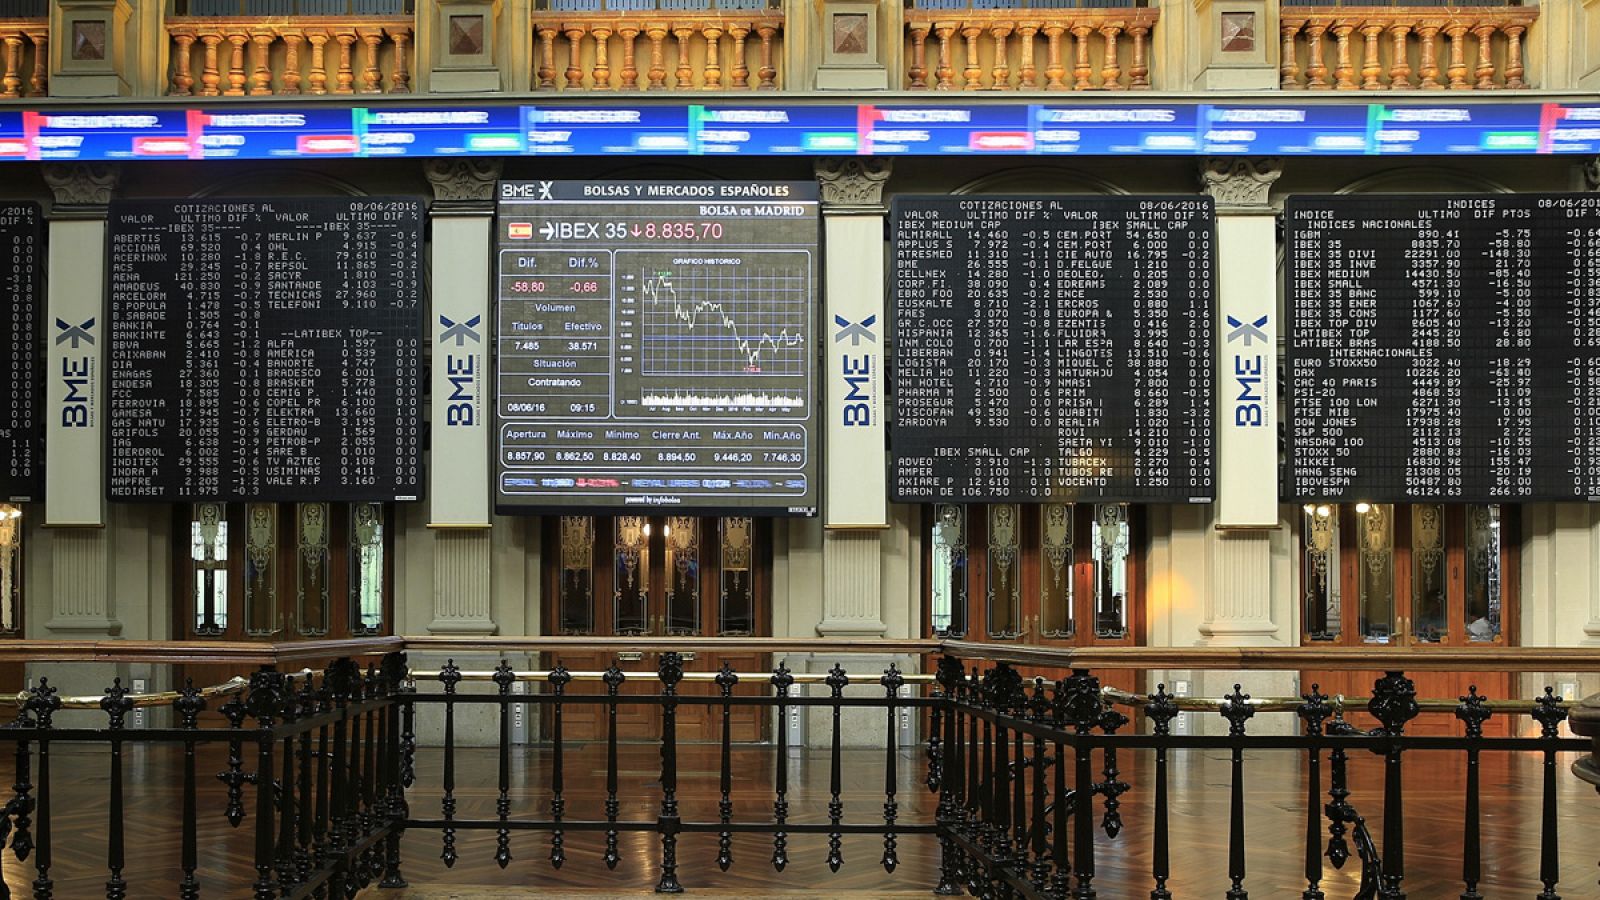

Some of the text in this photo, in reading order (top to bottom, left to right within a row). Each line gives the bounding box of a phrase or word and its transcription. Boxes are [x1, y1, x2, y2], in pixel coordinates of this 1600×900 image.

[502, 184, 534, 196] BME
[584, 184, 789, 196] BOLSAS Y MERCADOS ESPAÑOLES
[262, 204, 275, 212] AL
[700, 206, 736, 215] BOLSA
[755, 206, 804, 215] MADRID
[555, 223, 627, 238] IBEX 35
[645, 223, 722, 240] 8.835,70
[337, 261, 376, 269] 11.865
[518, 257, 536, 267] Dif.
[535, 304, 575, 312] Volumen
[565, 322, 601, 330] Efectivo
[533, 359, 576, 368] Situación
[342, 369, 375, 377] 6.001
[1343, 379, 1377, 387] PARIS
[62, 357, 88, 427] BME
[448, 355, 473, 426] BME
[844, 355, 869, 426] BME
[1236, 356, 1261, 426] BME
[570, 403, 595, 412] 09:15
[507, 430, 546, 440] Apertura
[557, 429, 592, 438] Máximo
[652, 431, 680, 439] Cierre
[683, 431, 701, 439] Ant.
[1504, 428, 1531, 436] 2.72
[508, 452, 801, 462] 8.857,90 8.862,50 8.828,40 8.894,50 9.446,20 7.746,30
[1490, 488, 1532, 496] 266.90
